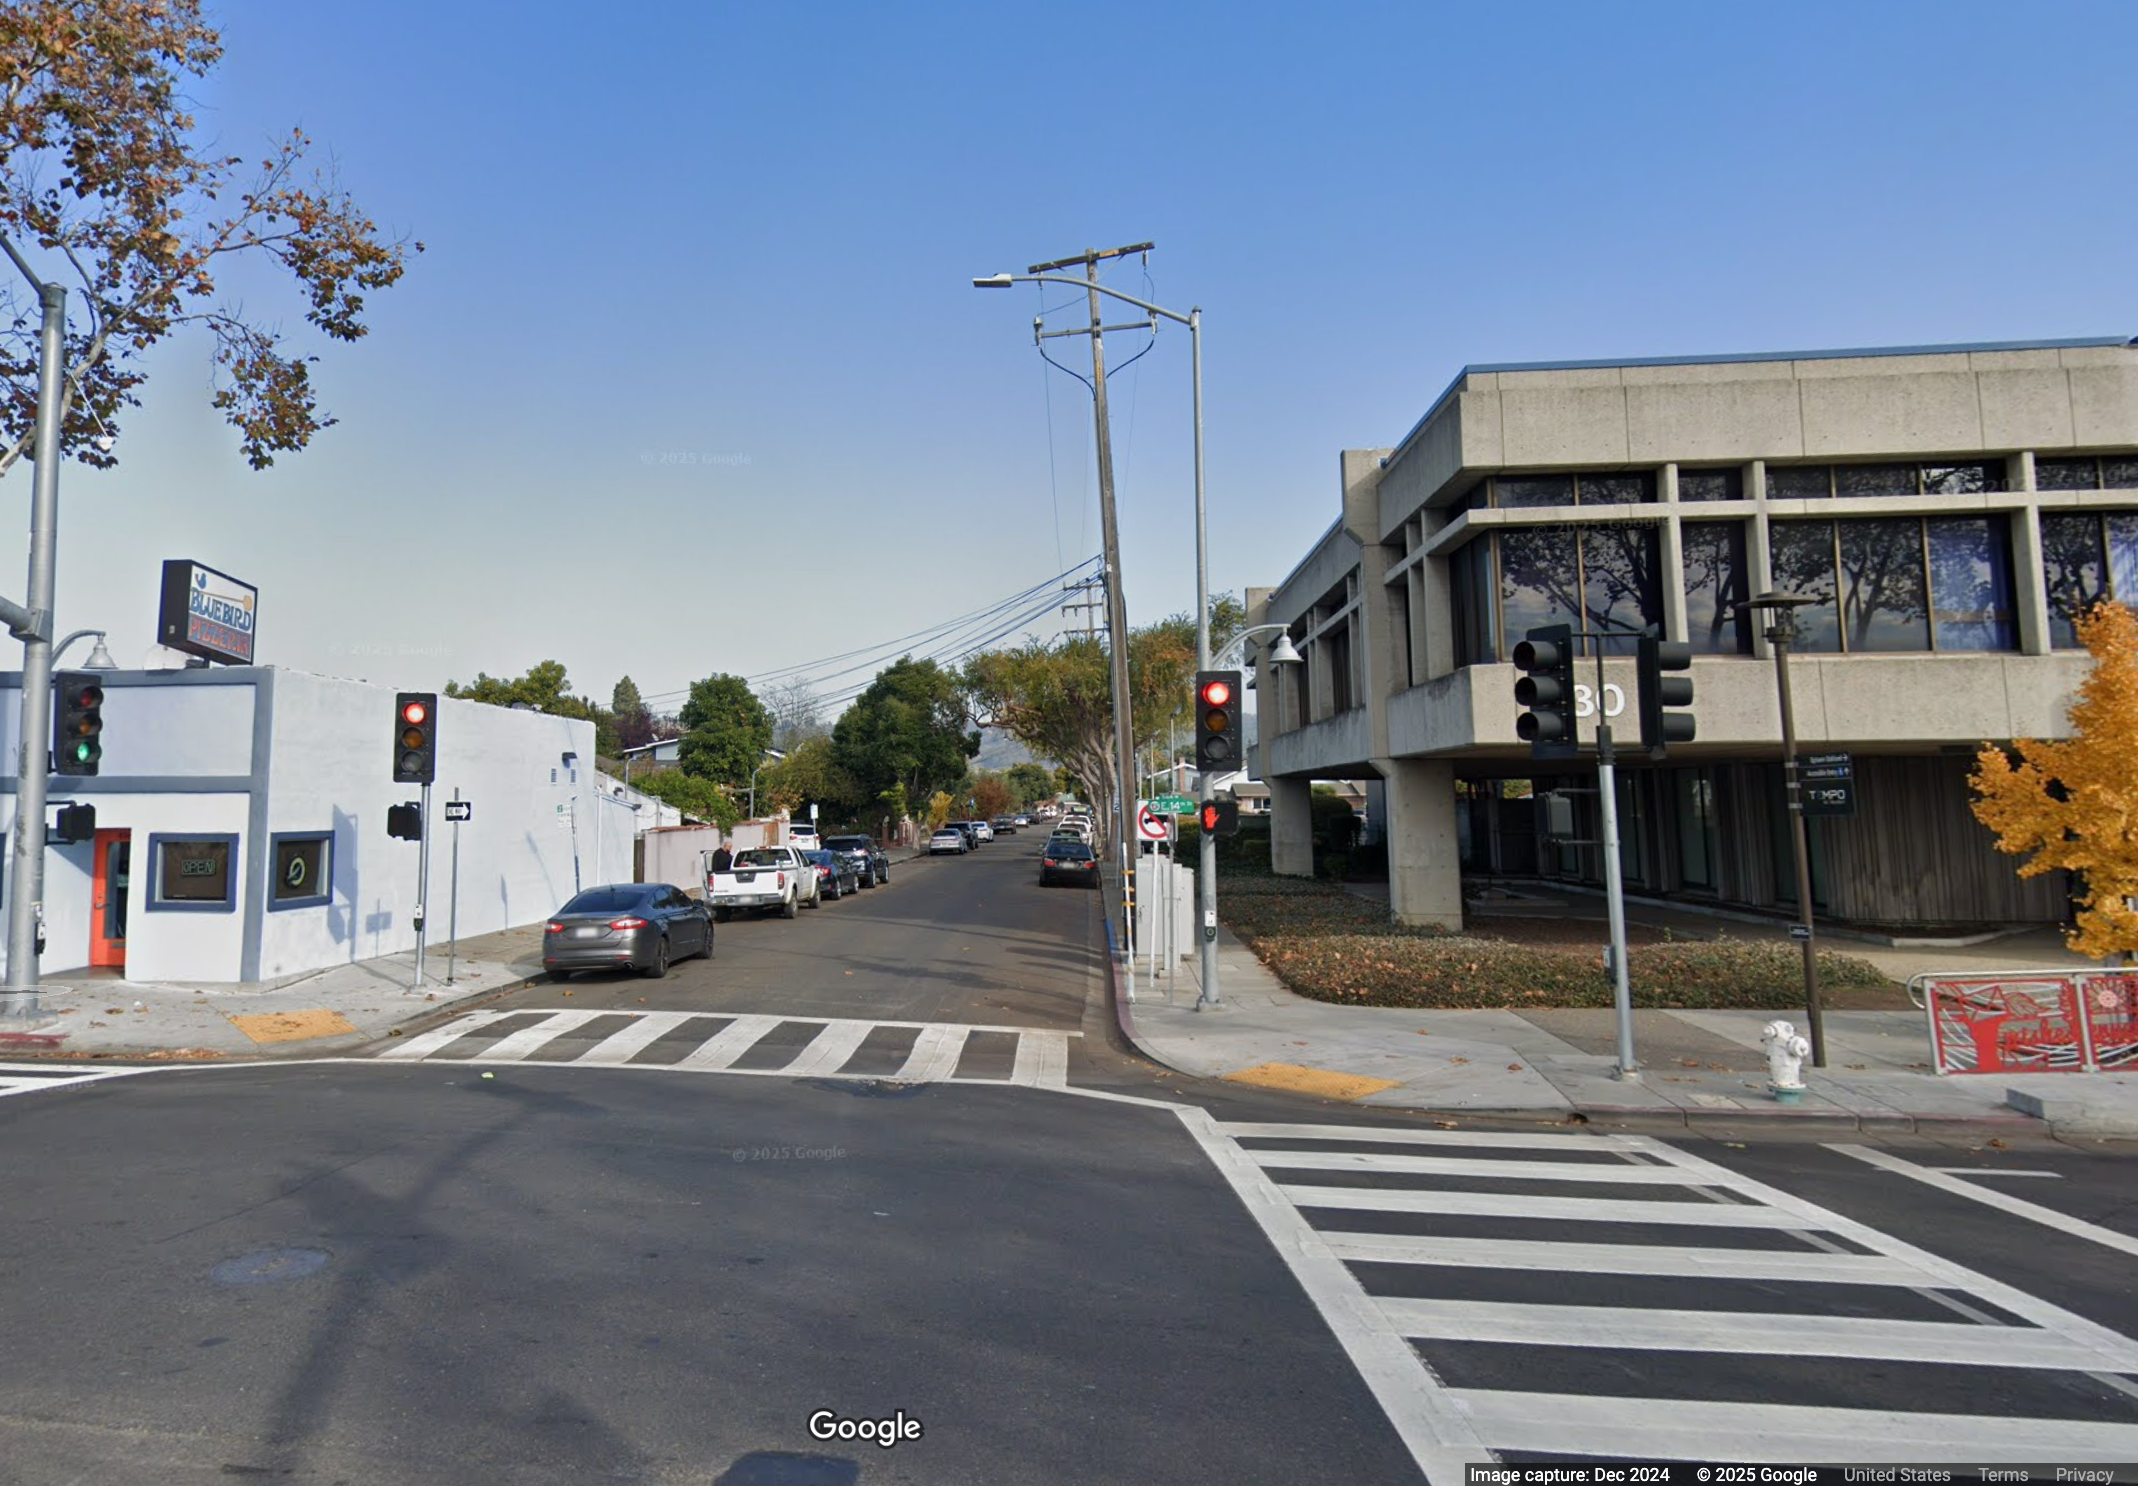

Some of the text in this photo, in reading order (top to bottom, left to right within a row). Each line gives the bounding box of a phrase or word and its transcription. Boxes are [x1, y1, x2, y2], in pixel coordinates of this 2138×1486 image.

[190, 587, 252, 632] BLUEBIRD
[189, 617, 250, 655] PIZZERIA
[183, 862, 213, 873] OPEN
